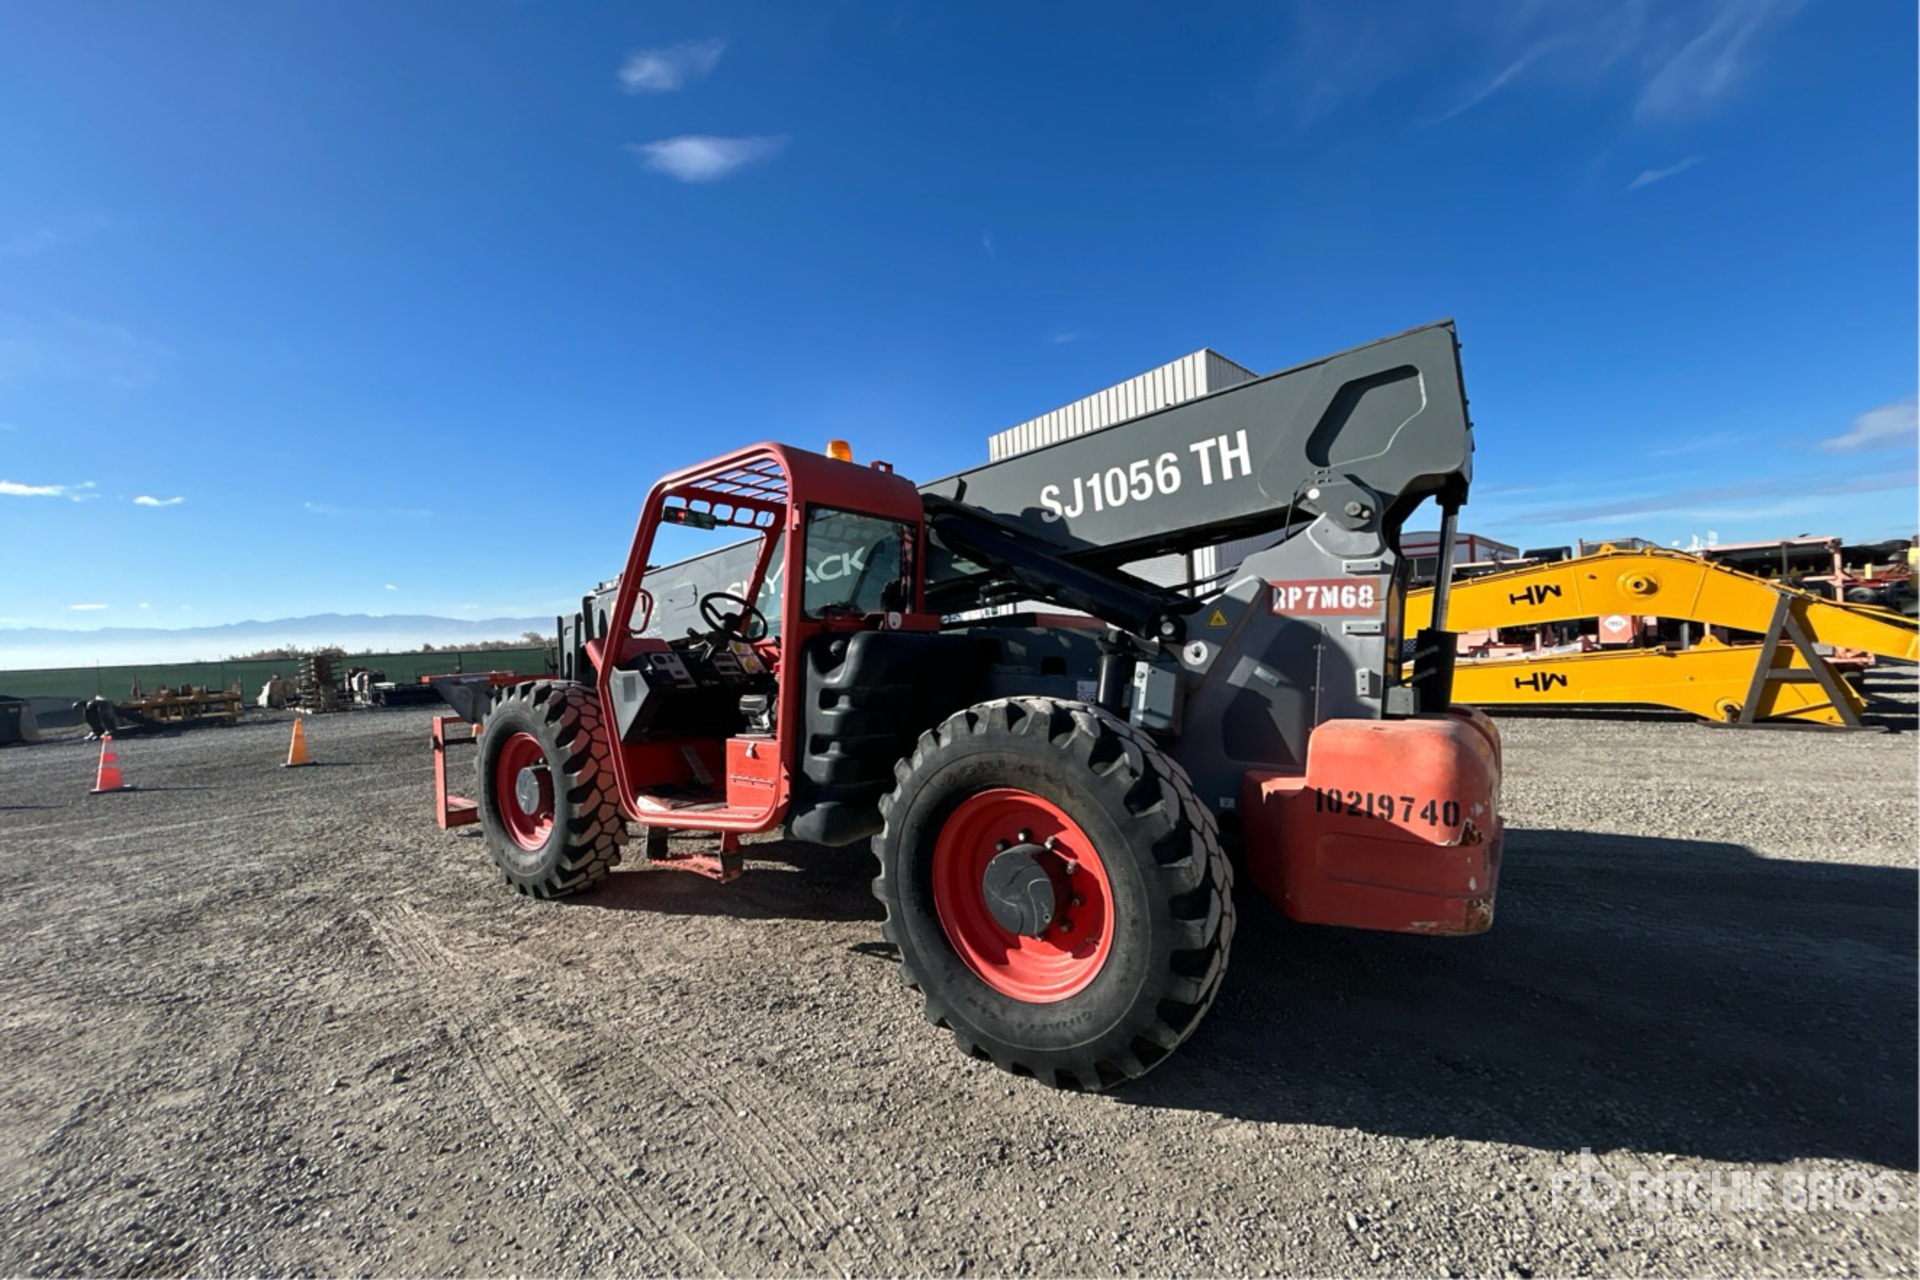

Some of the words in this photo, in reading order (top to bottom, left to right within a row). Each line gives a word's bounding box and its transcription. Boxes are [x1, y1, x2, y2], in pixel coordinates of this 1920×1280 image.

[1040, 452, 1182, 523] SJ1056
[1189, 429, 1252, 486] TH
[1273, 584, 1374, 610] RP7M68
[1315, 787, 1460, 828] 10219740
